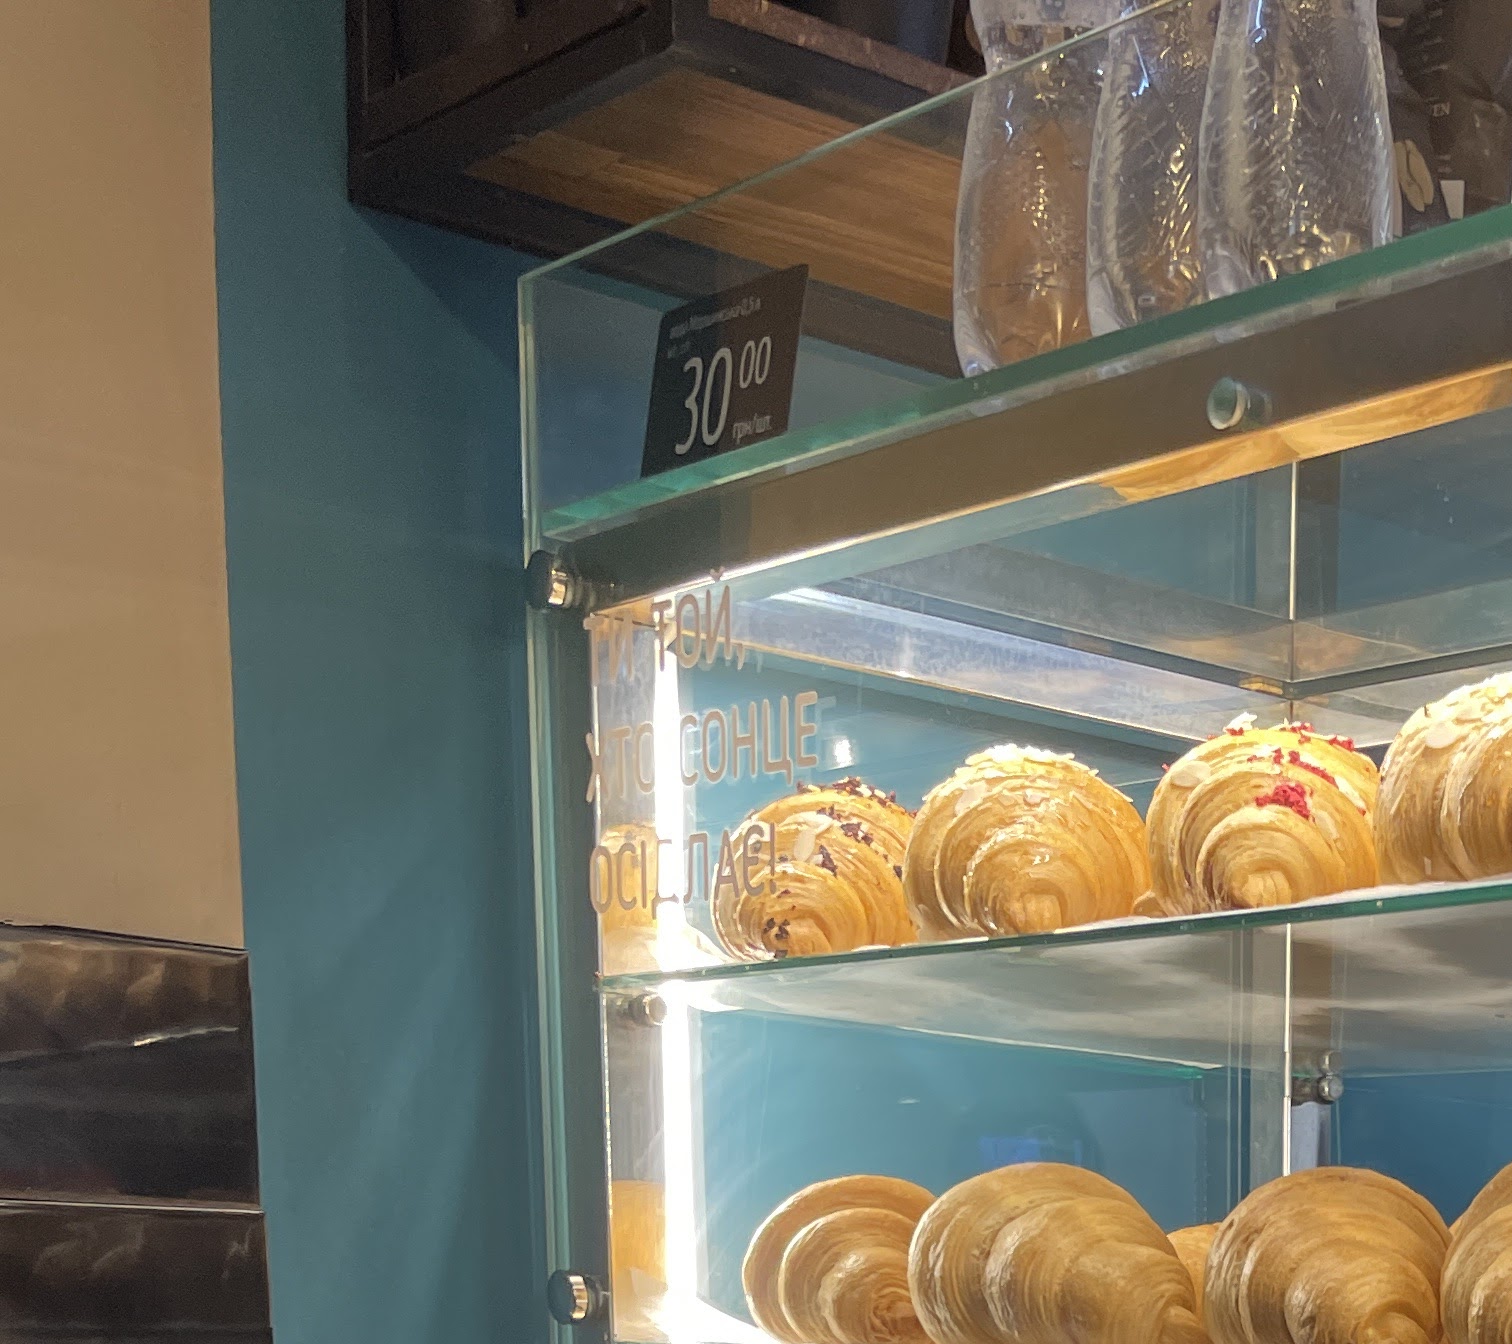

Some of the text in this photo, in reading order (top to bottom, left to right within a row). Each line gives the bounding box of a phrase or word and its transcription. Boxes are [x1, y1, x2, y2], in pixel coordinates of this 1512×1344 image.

[674, 336, 772, 455] 30 00
[679, 690, 818, 786] СОНЦЕ
